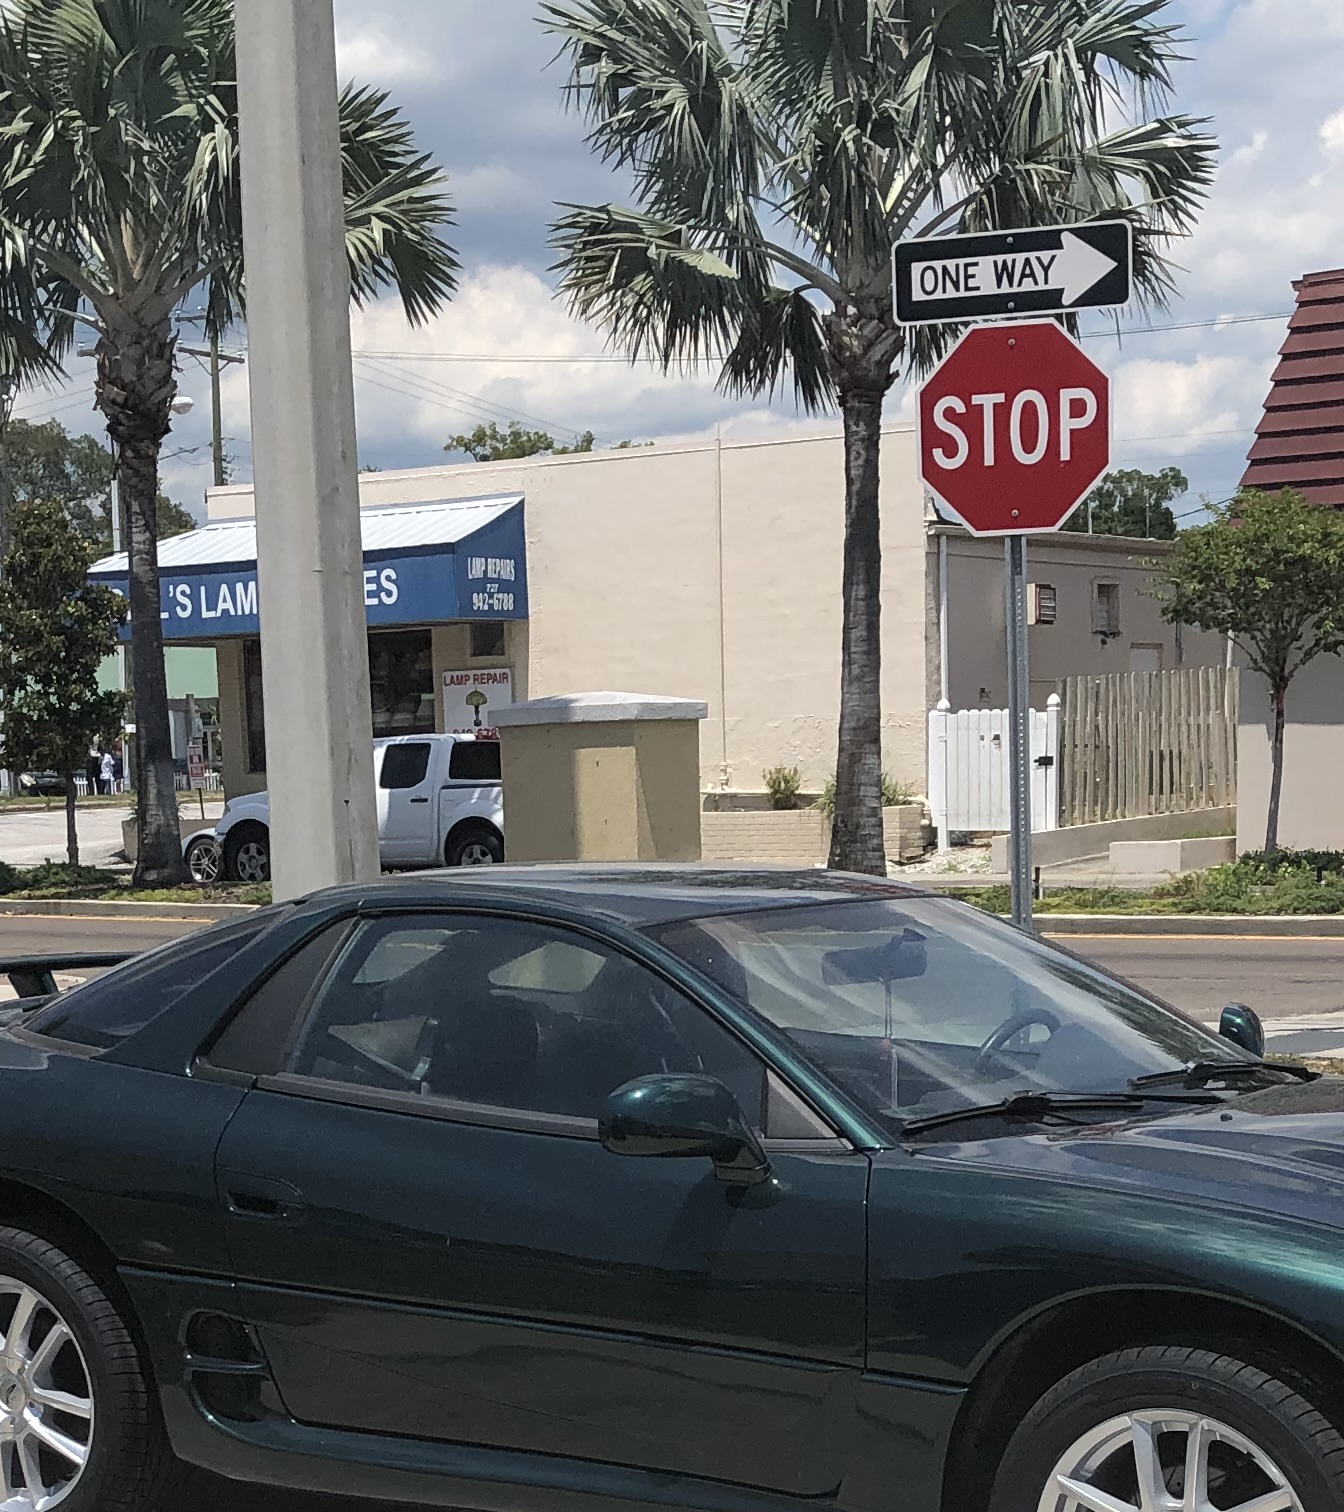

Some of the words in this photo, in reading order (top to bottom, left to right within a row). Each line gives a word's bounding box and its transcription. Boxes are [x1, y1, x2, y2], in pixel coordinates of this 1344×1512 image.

[919, 261, 981, 296] ONE
[993, 254, 1057, 289] WAY
[931, 387, 1098, 470] STOP
[467, 556, 486, 580] LAMP
[487, 557, 516, 582] REPAIRS
[200, 580, 258, 619] LAM
[486, 583, 499, 593] 727
[472, 592, 514, 611] 942-6788
[443, 673, 471, 687] LAMP
[472, 671, 509, 685] REPAIR
